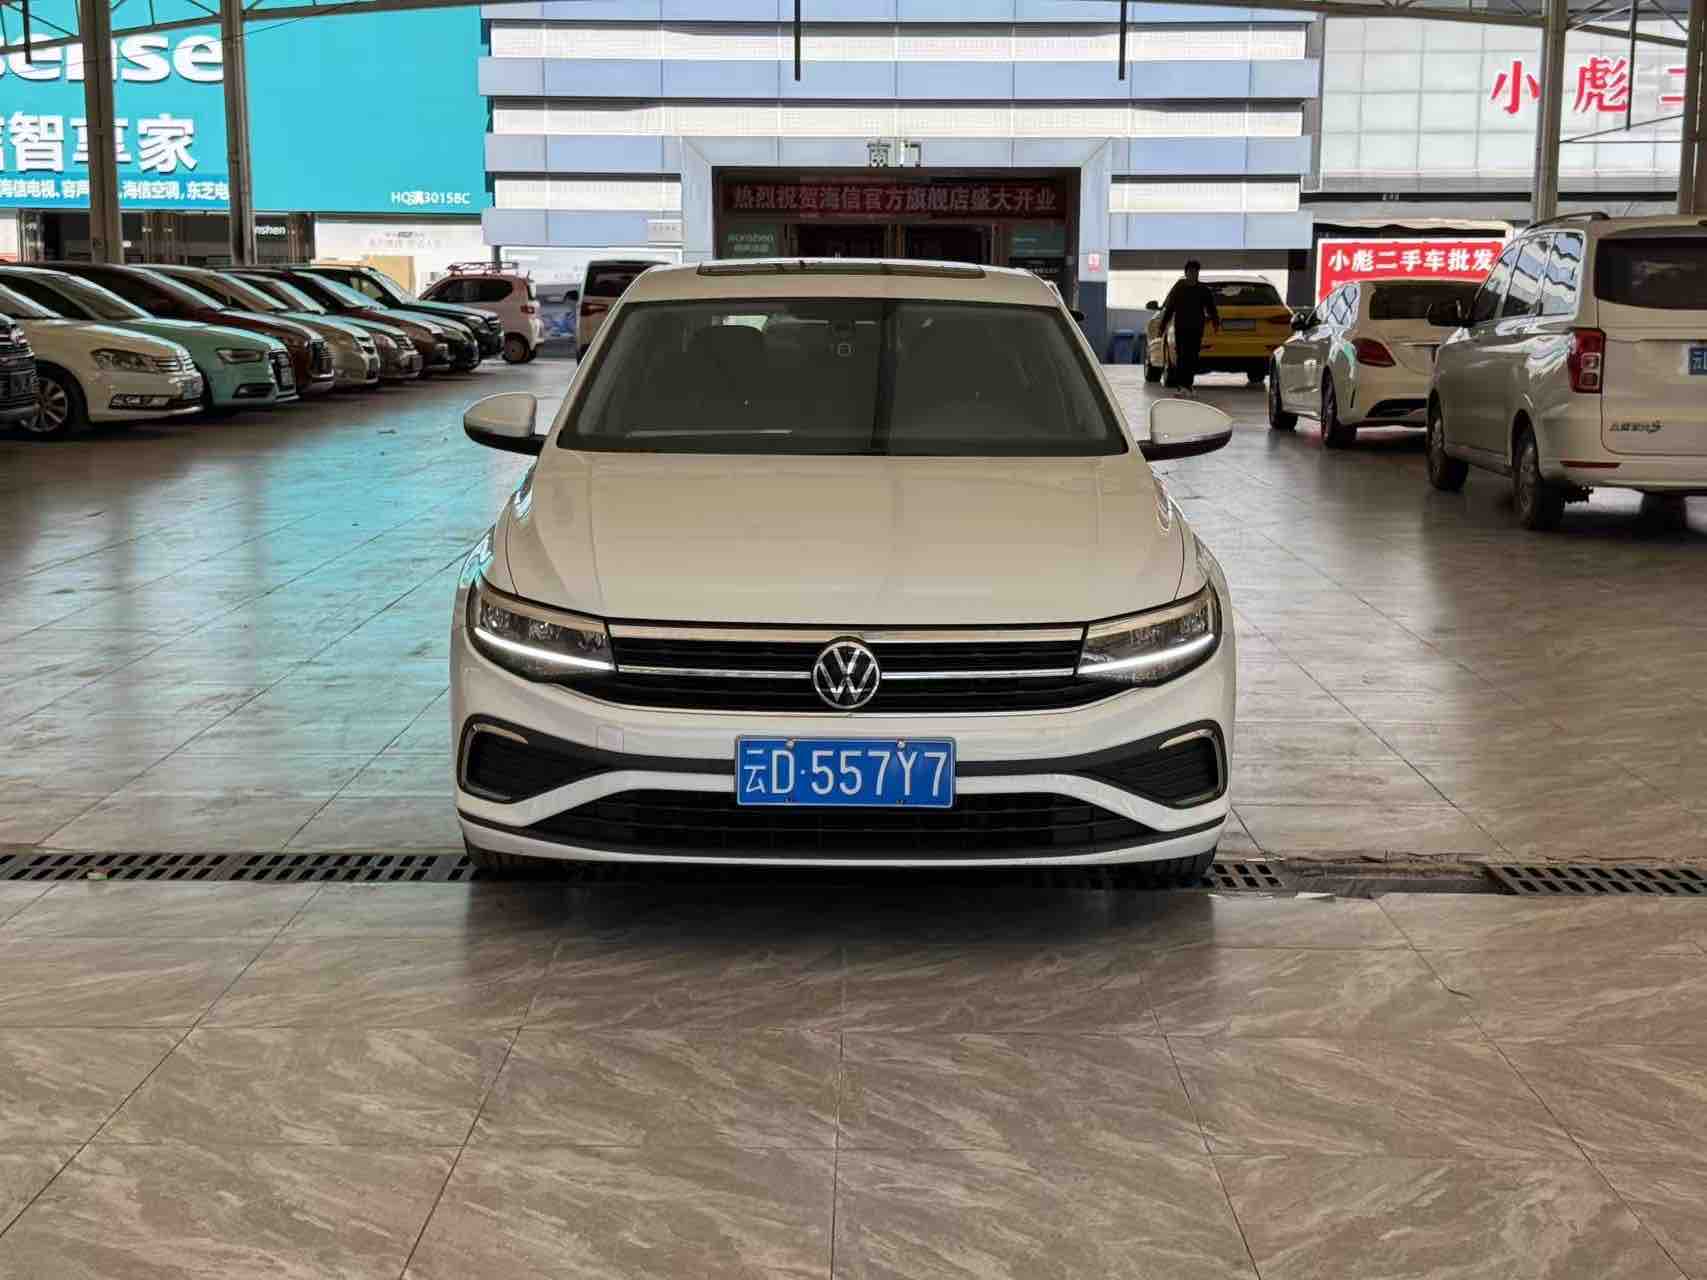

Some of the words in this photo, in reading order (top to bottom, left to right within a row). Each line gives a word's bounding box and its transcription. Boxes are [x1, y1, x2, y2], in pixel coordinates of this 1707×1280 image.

[0, 34, 224, 82] ese
[1327, 249, 1494, 272] 小彪二手车批发
